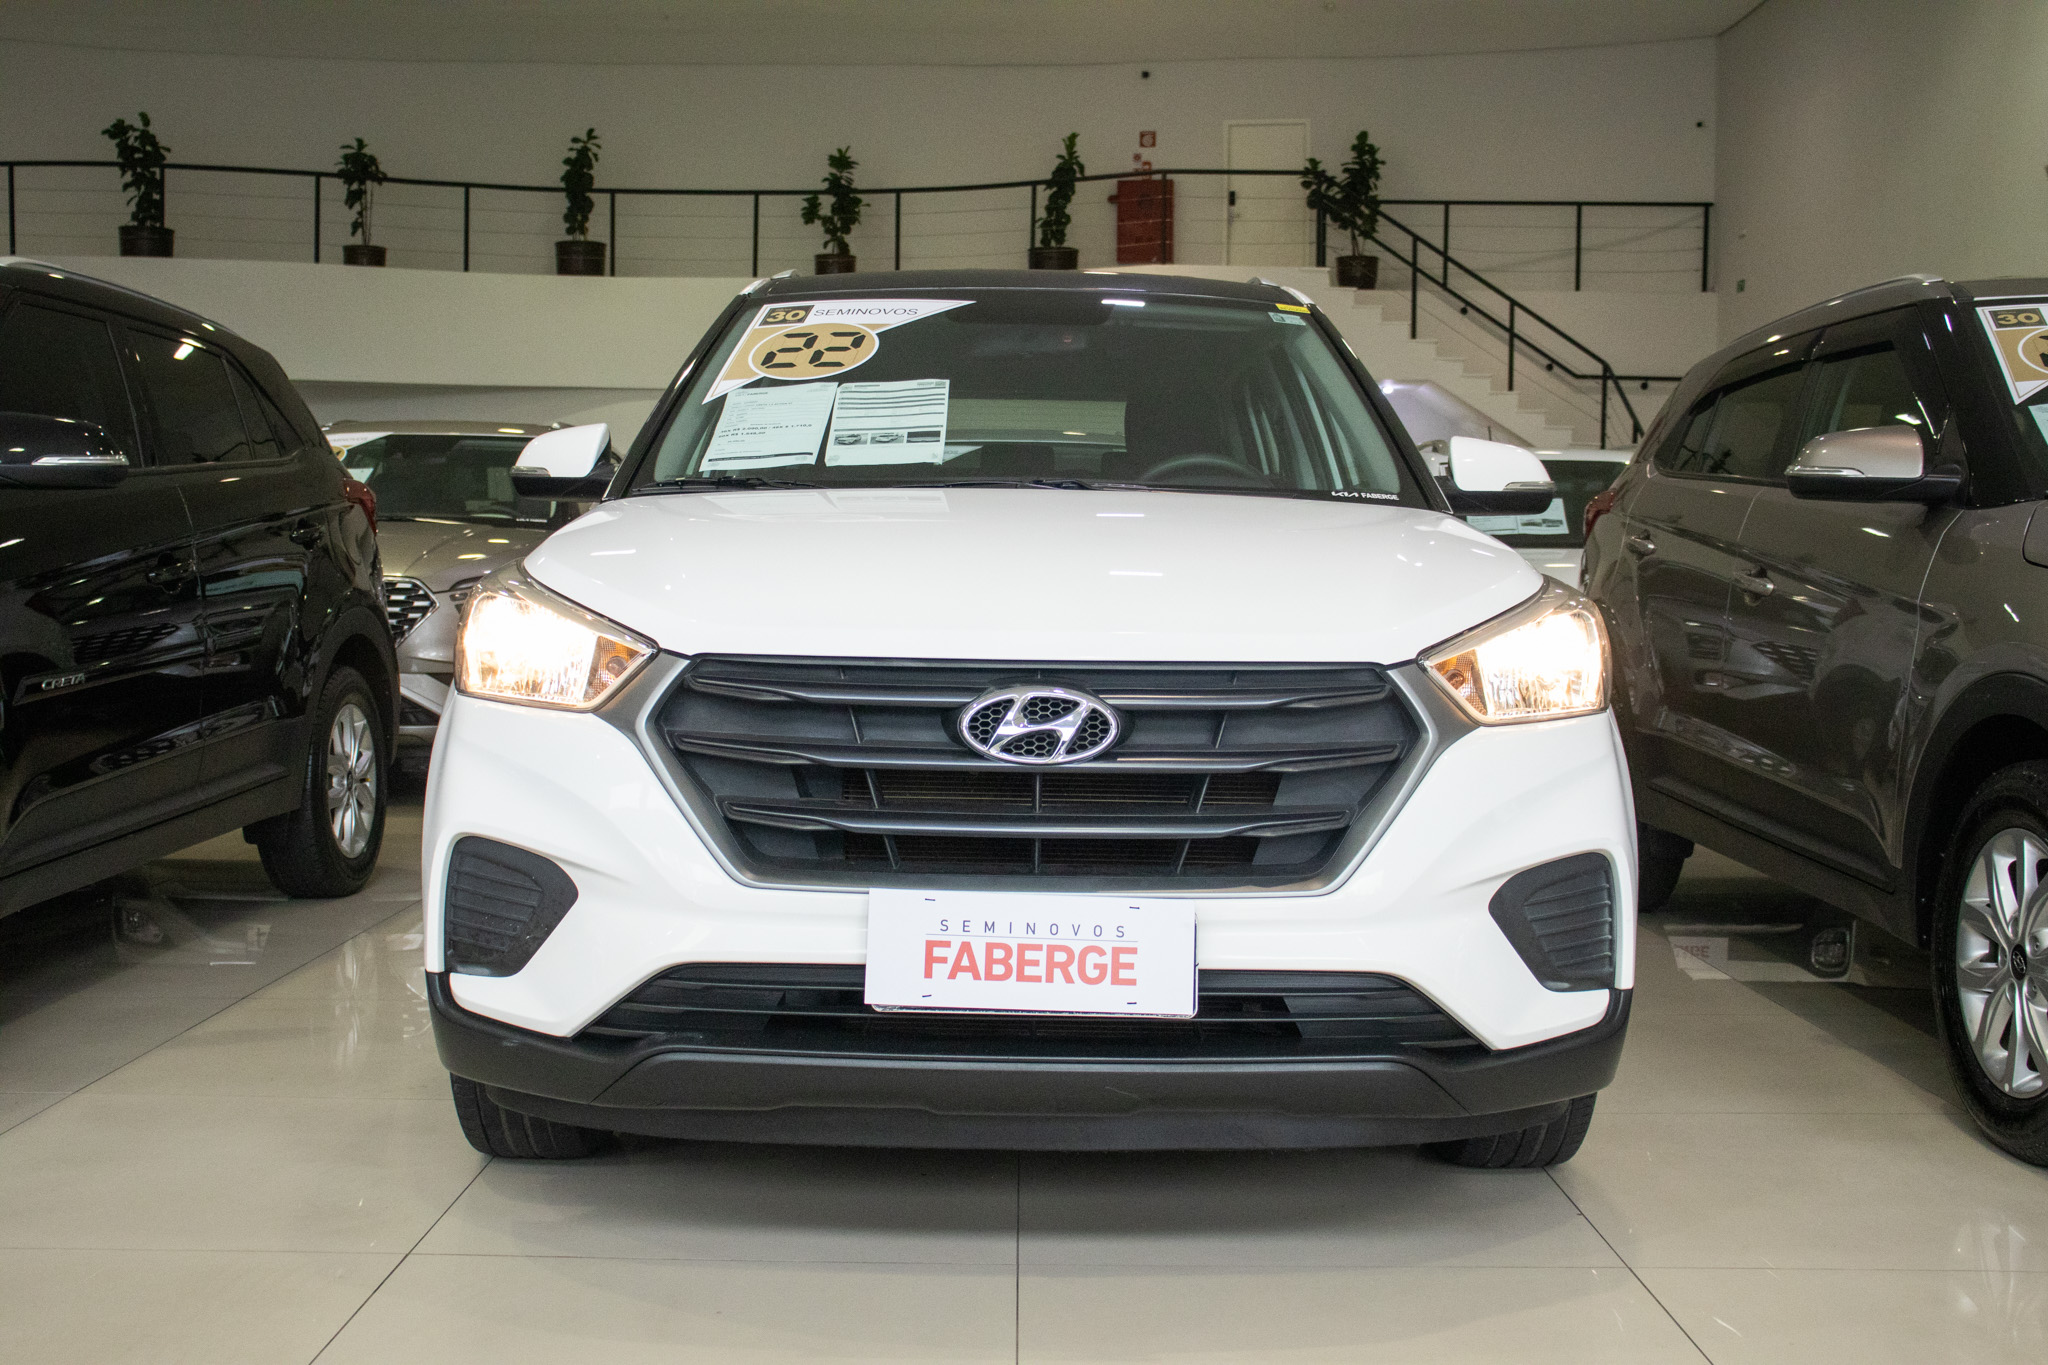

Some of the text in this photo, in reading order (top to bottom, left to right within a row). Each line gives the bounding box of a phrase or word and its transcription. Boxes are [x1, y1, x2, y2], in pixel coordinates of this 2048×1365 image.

[766, 310, 806, 322] 30
[813, 308, 919, 316] SEMINOVOS
[1997, 312, 2040, 325] 30
[760, 331, 866, 369] 22
[1360, 492, 1400, 500] FABERGE
[41, 672, 85, 691] CRETA
[940, 919, 1125, 938] SEMINOVOS
[924, 939, 1138, 987] FABERGE
